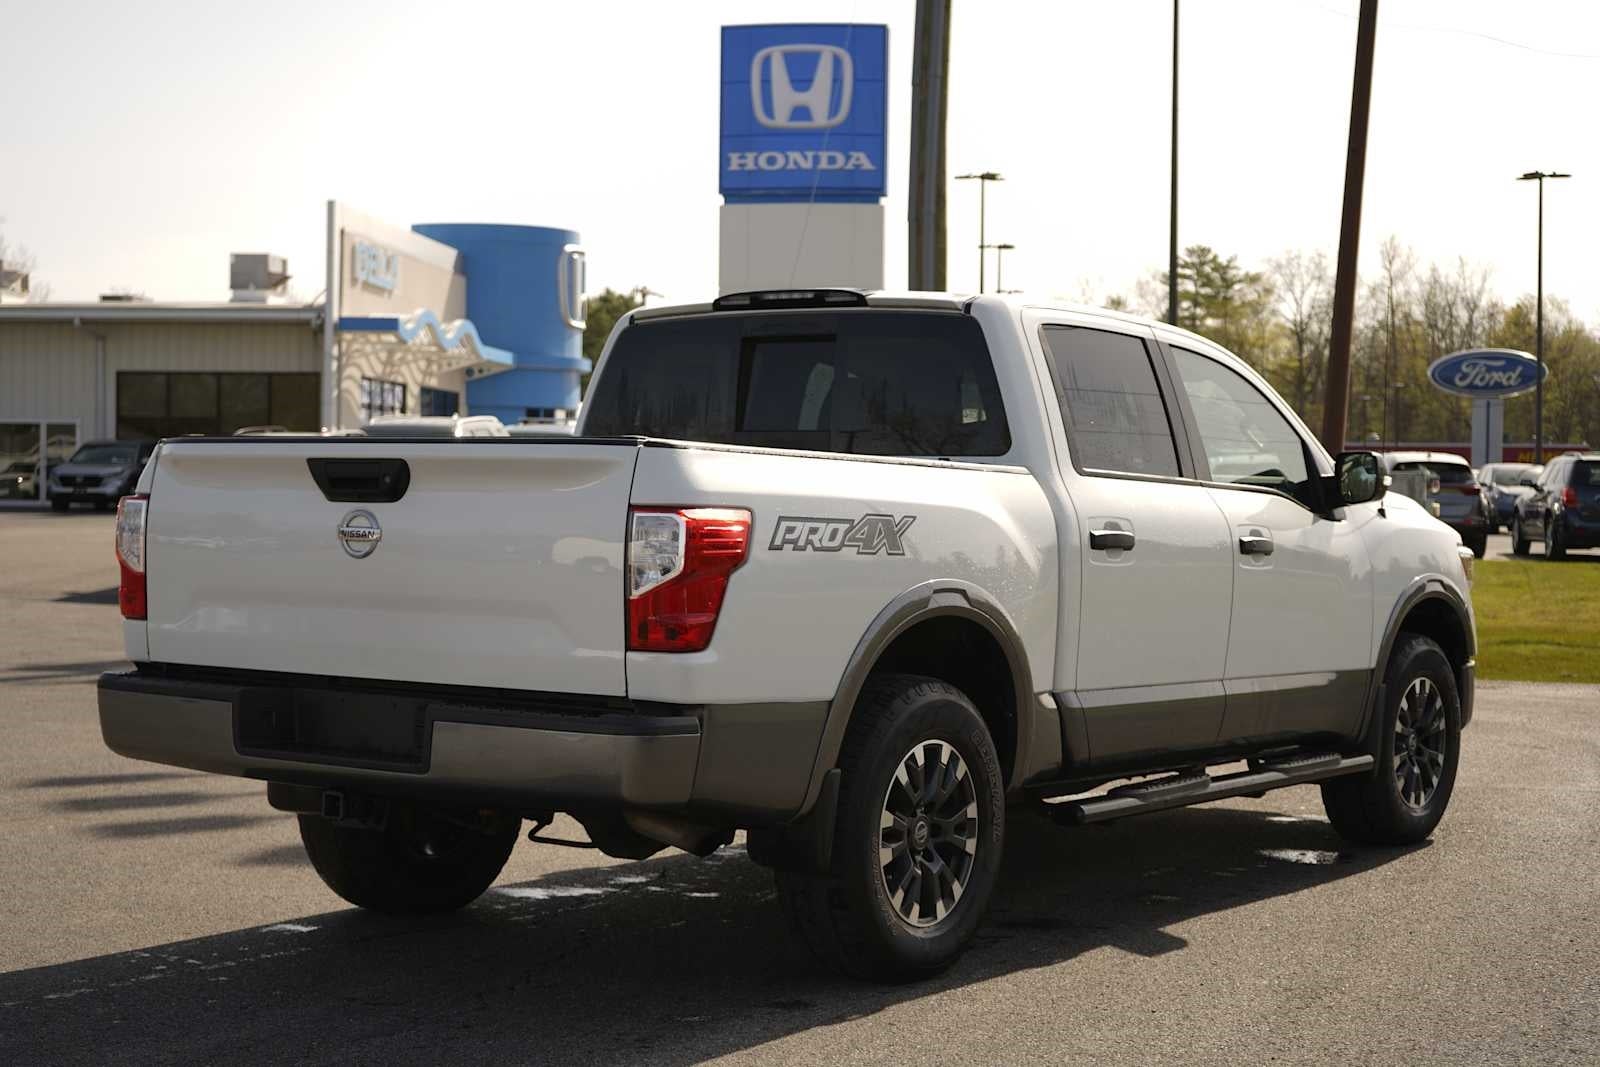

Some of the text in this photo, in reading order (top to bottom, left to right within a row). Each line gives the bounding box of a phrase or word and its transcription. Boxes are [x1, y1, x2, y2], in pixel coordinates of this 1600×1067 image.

[727, 151, 876, 171] HONDA
[1455, 359, 1523, 388] Ford
[341, 529, 376, 539] NISSAN
